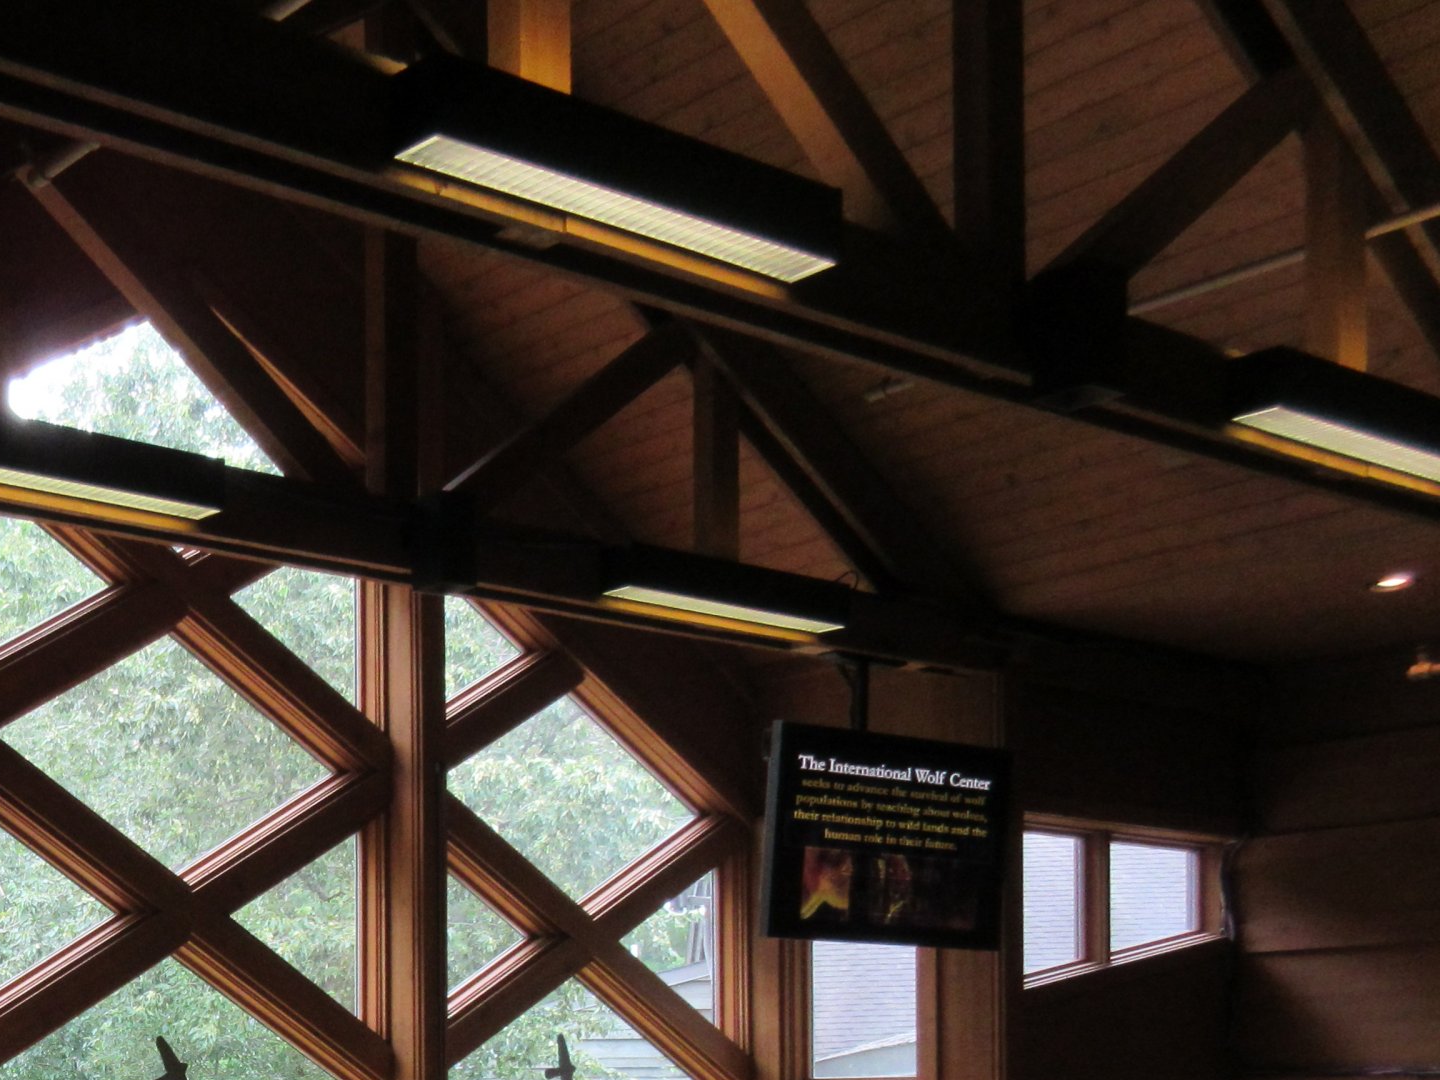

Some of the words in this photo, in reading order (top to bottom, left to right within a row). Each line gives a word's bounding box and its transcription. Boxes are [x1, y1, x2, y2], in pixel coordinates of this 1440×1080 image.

[798, 754, 826, 771] The
[828, 758, 912, 781] International
[915, 768, 947, 785] Wolf
[949, 773, 991, 791] Center
